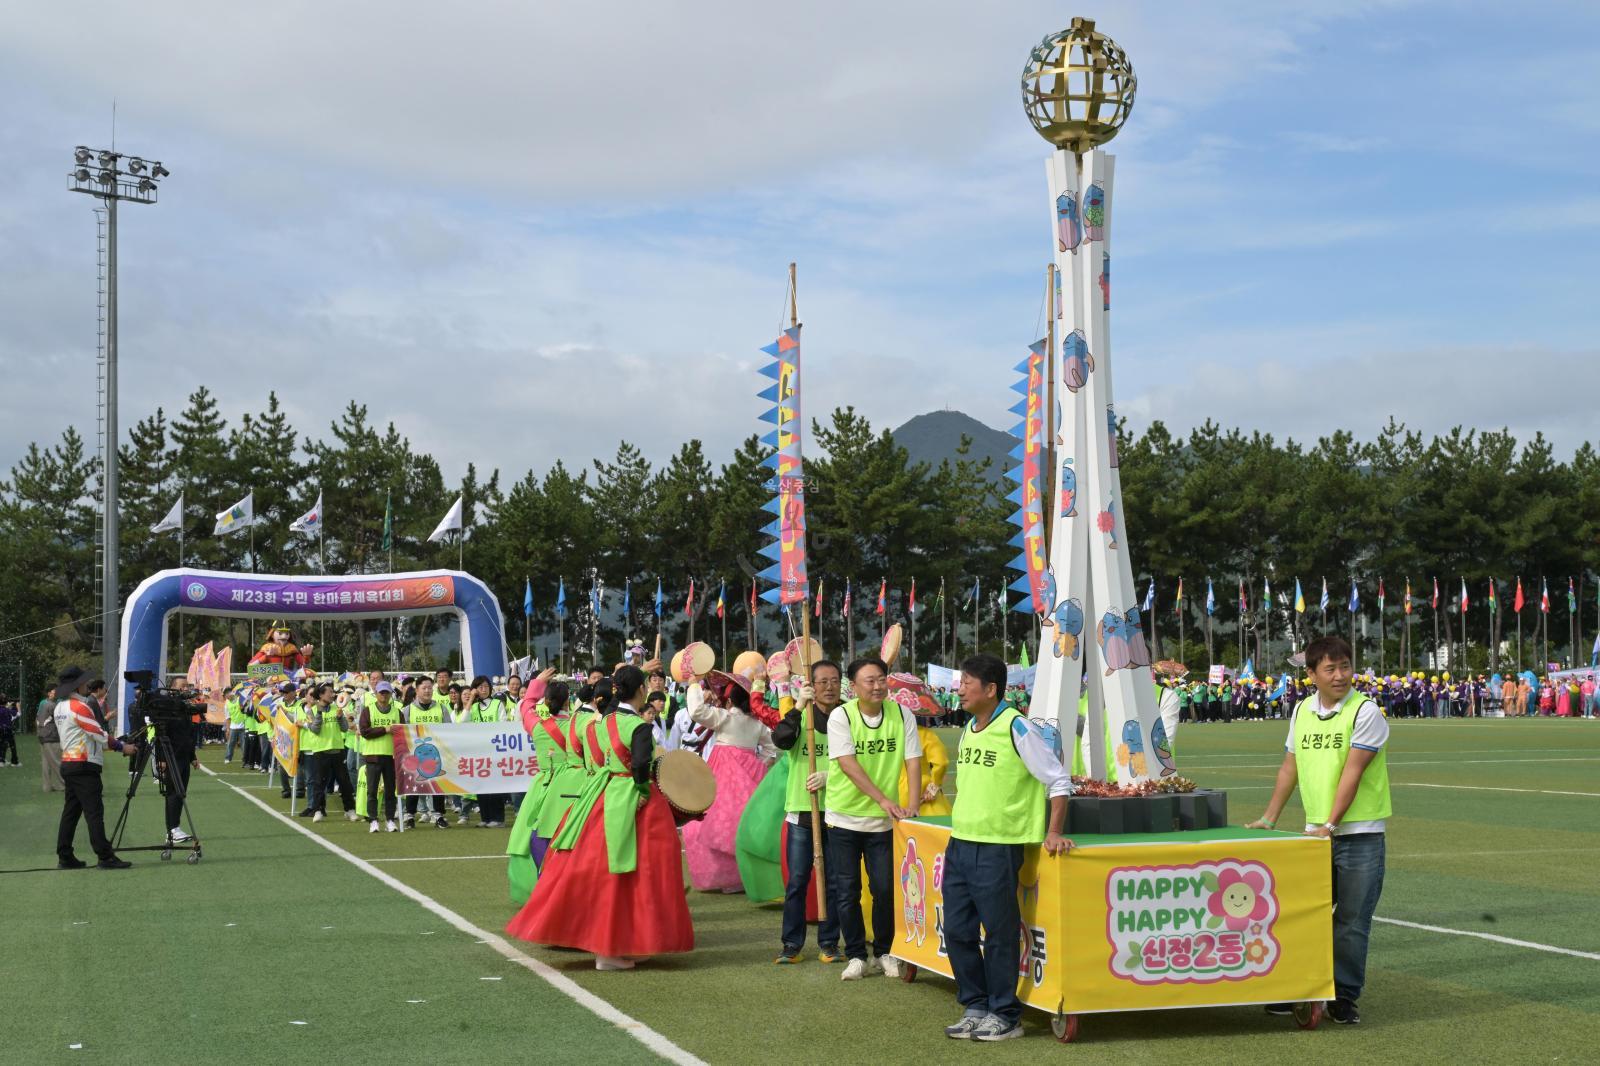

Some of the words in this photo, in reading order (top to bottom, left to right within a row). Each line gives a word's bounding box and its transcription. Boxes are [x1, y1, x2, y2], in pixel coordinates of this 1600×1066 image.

[231, 588, 277, 605] 제23회
[282, 590, 308, 605] 구민
[491, 733, 523, 752] 신이
[855, 737, 897, 755] 신정2동
[1301, 732, 1344, 750] 신정2동
[457, 756, 492, 778] 최강
[496, 755, 540, 777] 신2동
[1116, 876, 1206, 901] HAPPY
[1117, 907, 1207, 933] HAPPY
[1141, 933, 1245, 968] 신정2동
